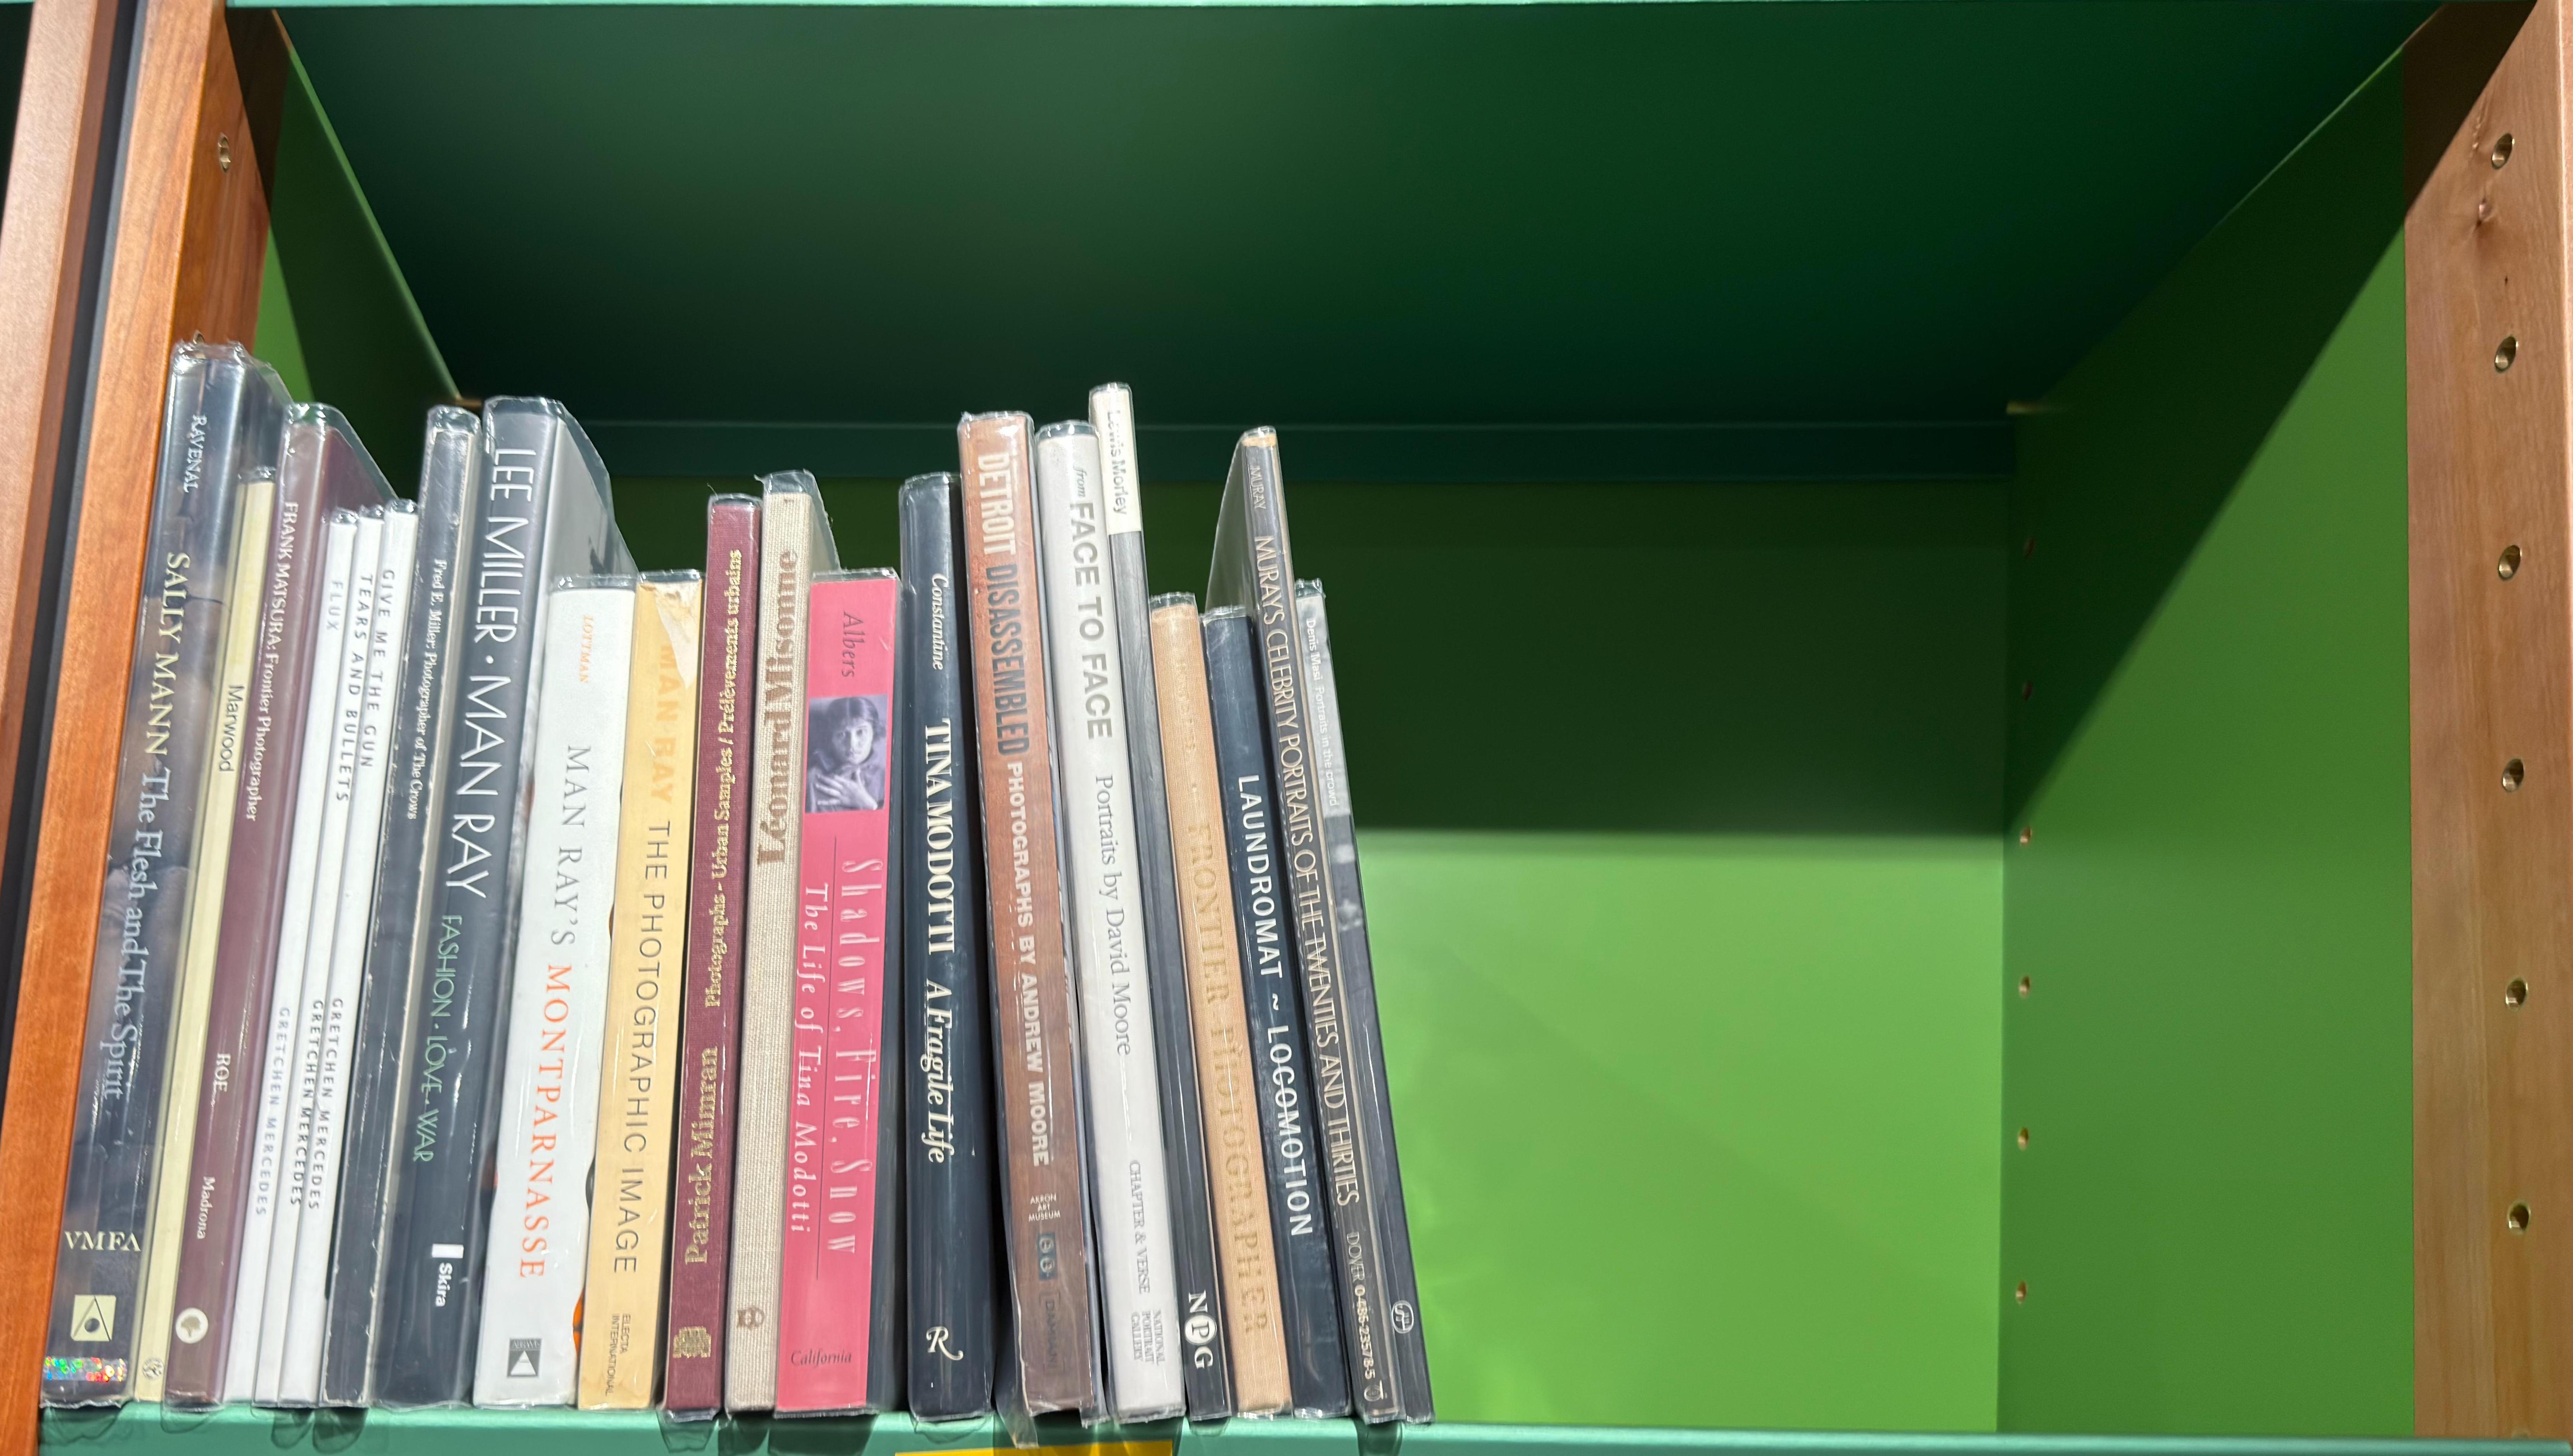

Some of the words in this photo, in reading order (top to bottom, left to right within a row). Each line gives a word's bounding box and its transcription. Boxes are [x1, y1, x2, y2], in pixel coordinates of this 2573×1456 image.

[183, 413, 208, 494] RAVENAL
[490, 448, 537, 502] LEE
[1073, 467, 1088, 498] from
[1112, 459, 1127, 515] Morley
[977, 451, 1017, 555] DETROIT
[1249, 465, 1266, 510] MURAY
[277, 501, 299, 560] FRANK
[1069, 502, 1100, 587] FACE
[159, 552, 191, 644] SALLY
[267, 562, 291, 650] MATSURA:
[326, 580, 344, 631] FLUX
[354, 574, 373, 641] TEARS
[377, 569, 395, 619] GIVE
[431, 592, 444, 607] E.
[432, 558, 448, 590] Fred
[474, 516, 529, 644] MILLER
[725, 549, 743, 615] urbains
[373, 631, 389, 658] ME
[579, 614, 594, 684] LOTTMAN
[766, 550, 798, 707] Misonne
[841, 611, 866, 678] Albers
[931, 573, 949, 671] Constantine
[1077, 596, 1105, 642] TO
[1306, 620, 1317, 652] Denis
[259, 653, 279, 714] Frontier
[348, 652, 364, 696] AND
[366, 669, 384, 711] THE
[658, 644, 681, 722] MAN
[718, 617, 739, 734] Prélèvements
[986, 562, 1030, 757] DISASSEMBLED
[1265, 630, 1299, 729] CELEBRITY
[1309, 653, 1323, 681] Masi
[145, 652, 180, 756] MANN
[413, 653, 437, 736] Photographer
[1082, 653, 1113, 740] FACE
[1314, 687, 1327, 735] Portraits
[219, 685, 245, 773] Marwood
[336, 708, 358, 802] BULLETS
[359, 724, 377, 767] GUN
[415, 737, 427, 751] of
[456, 675, 511, 795] MAN
[925, 718, 953, 798] TINA
[1321, 736, 1329, 747] in
[1323, 748, 1332, 769] the
[138, 767, 172, 824] The
[246, 716, 272, 821] Photographer
[412, 751, 426, 778] The
[562, 745, 591, 827] MAN
[652, 737, 676, 803] RAY
[714, 747, 736, 821] Samples
[757, 710, 792, 867] Léonard
[1279, 734, 1313, 847] PORTRAITS
[1325, 770, 1338, 807] crowd
[407, 778, 424, 820] Crows
[1096, 773, 1119, 866] Portraits
[127, 829, 164, 900] Flesh
[446, 814, 495, 898] RAY
[645, 820, 671, 880] THE
[711, 823, 730, 880] Urban
[926, 799, 954, 955] MODOTTI
[1007, 760, 1033, 928] PHOTOGRAPHS
[1293, 849, 1318, 883] OF
[804, 882, 829, 931] The
[1099, 870, 1123, 901] by
[1298, 884, 1324, 931] THE
[120, 906, 149, 956] and
[705, 893, 728, 1008] Photographs
[833, 858, 884, 1032] Shadows,
[1019, 935, 1037, 965] BY
[1106, 908, 1130, 975] David
[114, 959, 147, 1017] The
[431, 915, 462, 1017] FASHION
[797, 944, 826, 994] Life
[926, 977, 953, 1001] A
[1304, 932, 1339, 1048] TWENTIES
[624, 894, 665, 1153] PHOTOGRAPHIC
[794, 1007, 823, 1033] of
[1021, 971, 1044, 1074] ANDREW
[1112, 982, 1132, 1056] Moore
[1238, 775, 1283, 979] LAUNDROMAT
[1267, 1025, 1313, 1236] LOCOMOTION
[100, 1023, 138, 1100] Spirit
[214, 1052, 231, 1093] ROE
[268, 1006, 290, 1106] GRETCHEN
[302, 999, 323, 1099] GRETCHEN
[321, 998, 343, 1099] GRETCHEN
[421, 1036, 448, 1094] LOVE
[796, 1045, 822, 1107] Tina
[920, 1007, 954, 1105] Fragile
[1187, 822, 1229, 1003] FRONTIER
[1210, 1026, 1268, 1333] PHOTOGRAPHER
[1319, 1054, 1346, 1109] AND
[519, 964, 572, 1278] MONTPARNASSE
[691, 1046, 718, 1159] Mimran
[829, 1048, 877, 1143] Fire,
[1027, 1080, 1049, 1167] MOORE
[256, 1117, 278, 1216] MERCEDES
[290, 1107, 312, 1207] MERCEDES
[308, 1110, 330, 1210] MERCEDES
[413, 1108, 439, 1162] WAR
[921, 1110, 955, 1164] Life
[1327, 1118, 1360, 1207] THIRTIES
[197, 1176, 216, 1240] Madrona
[790, 1120, 817, 1233] Modotti
[827, 1159, 873, 1254] Snow
[1030, 1193, 1057, 1204] AKRON
[1037, 1203, 1051, 1212] ART
[1129, 1160, 1146, 1229] CHAPTER
[64, 1231, 141, 1252] VMFA
[614, 1168, 644, 1273] IMAGE
[685, 1163, 712, 1265] Patrick
[1028, 1210, 1061, 1222] MUSEUM
[1135, 1231, 1146, 1245] &
[435, 1262, 453, 1307] Skira
[1137, 1247, 1150, 1294] VERSE
[1347, 1232, 1364, 1281] DOVER
[605, 1314, 620, 1396] INTERNATIONAL
[620, 1313, 631, 1354] ELECTA
[790, 1349, 852, 1369] California
[1131, 1313, 1143, 1361] GALLERY
[1143, 1311, 1155, 1363] PORTRAIT
[1153, 1309, 1165, 1365] NATIONAL
